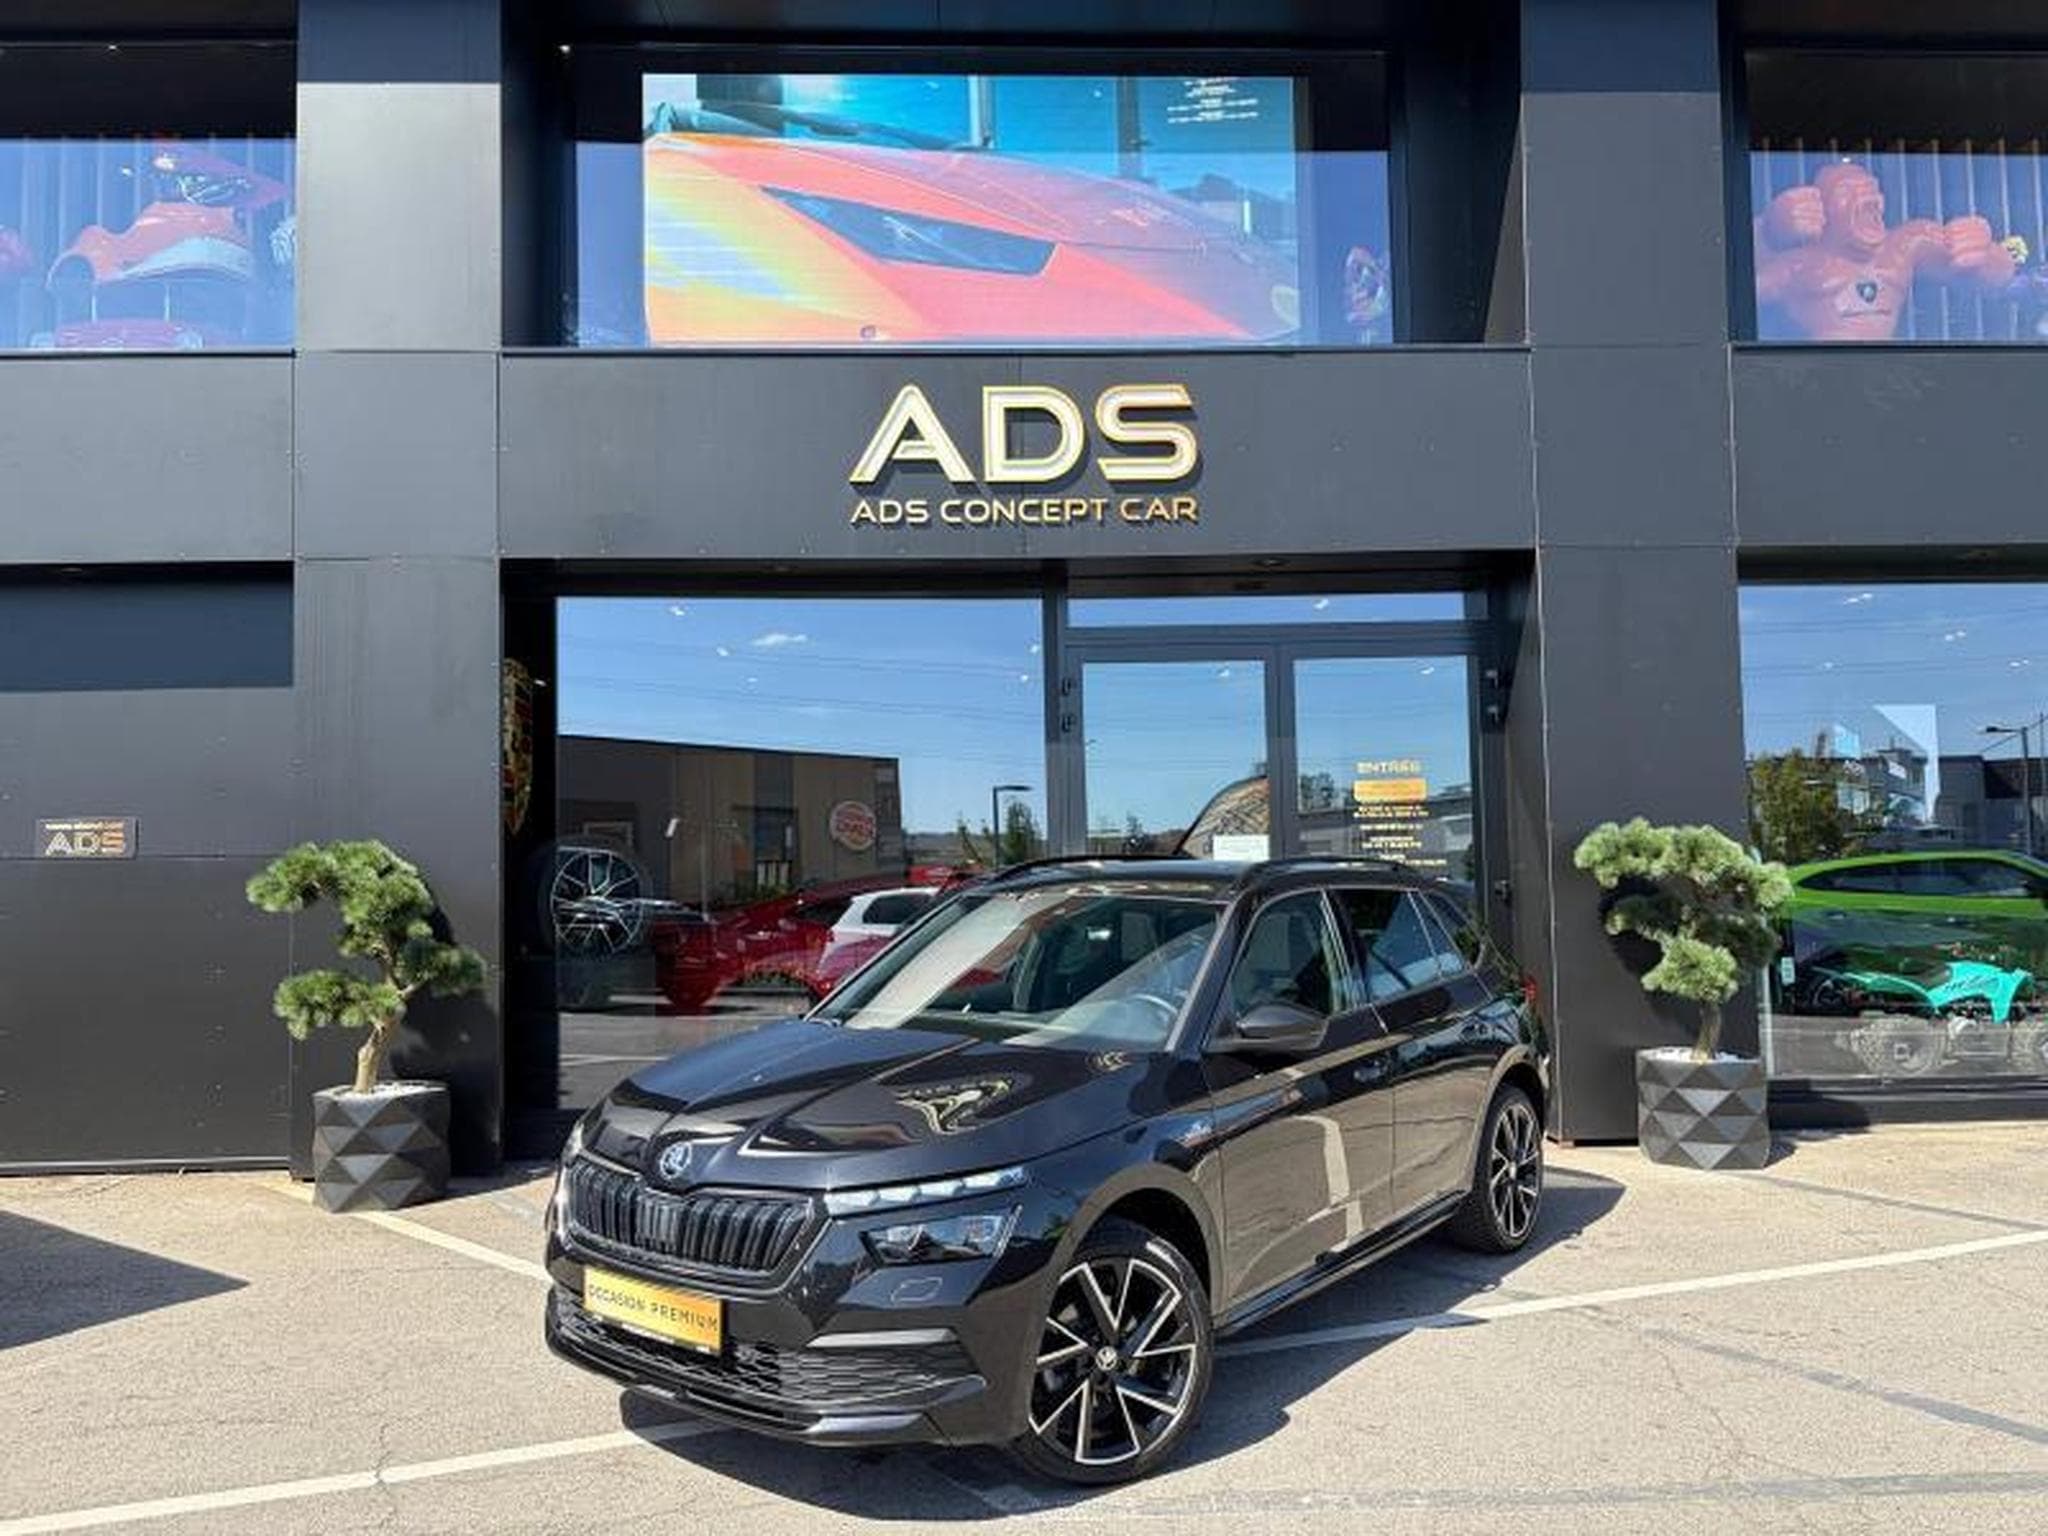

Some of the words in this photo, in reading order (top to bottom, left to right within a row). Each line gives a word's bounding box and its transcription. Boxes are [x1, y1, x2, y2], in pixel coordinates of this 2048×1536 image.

[849, 383, 1198, 484] ADS
[850, 500, 929, 524] ADS
[940, 498, 1108, 524] CONCEPT
[1119, 497, 1197, 521] CAR
[44, 831, 126, 856] ADS
[587, 1283, 646, 1311] OCCASION
[650, 1302, 719, 1332] PREMIUM
